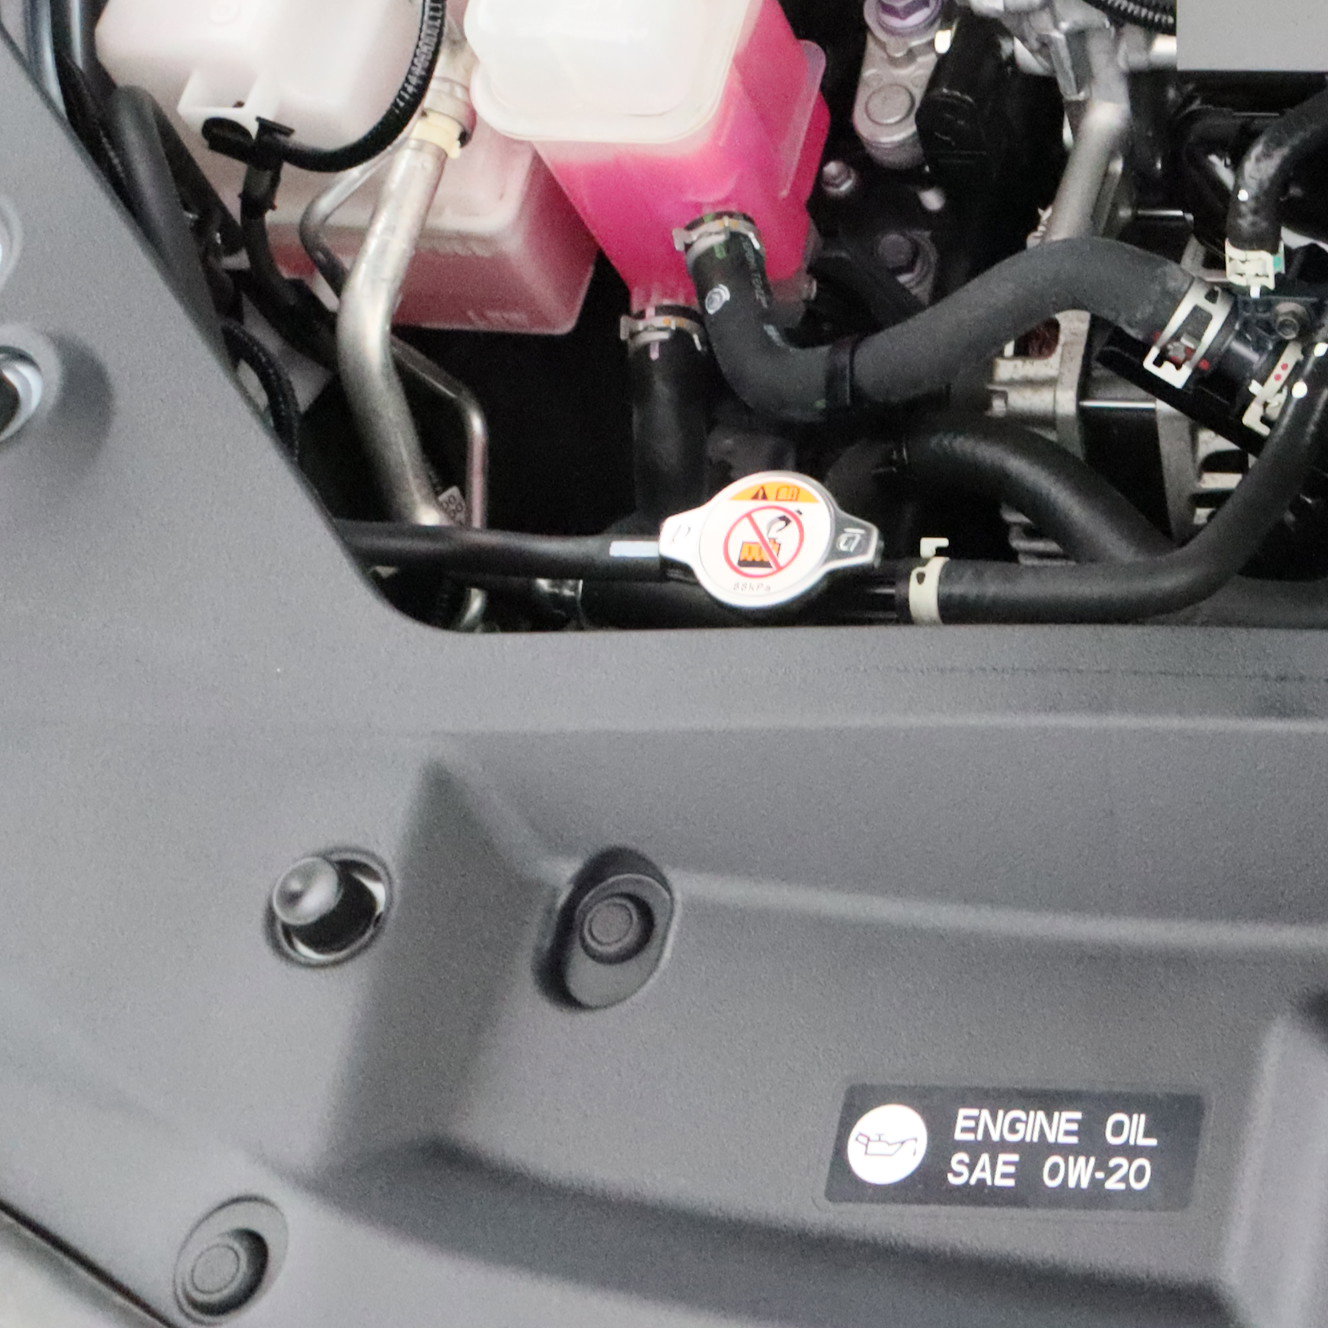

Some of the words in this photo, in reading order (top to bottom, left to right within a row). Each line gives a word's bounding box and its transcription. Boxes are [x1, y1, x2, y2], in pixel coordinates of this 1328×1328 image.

[953, 1107, 1083, 1145] ENGINE
[1104, 1112, 1158, 1147] OIL
[946, 1151, 1020, 1188] SAE
[1042, 1154, 1152, 1191] 0W-20
